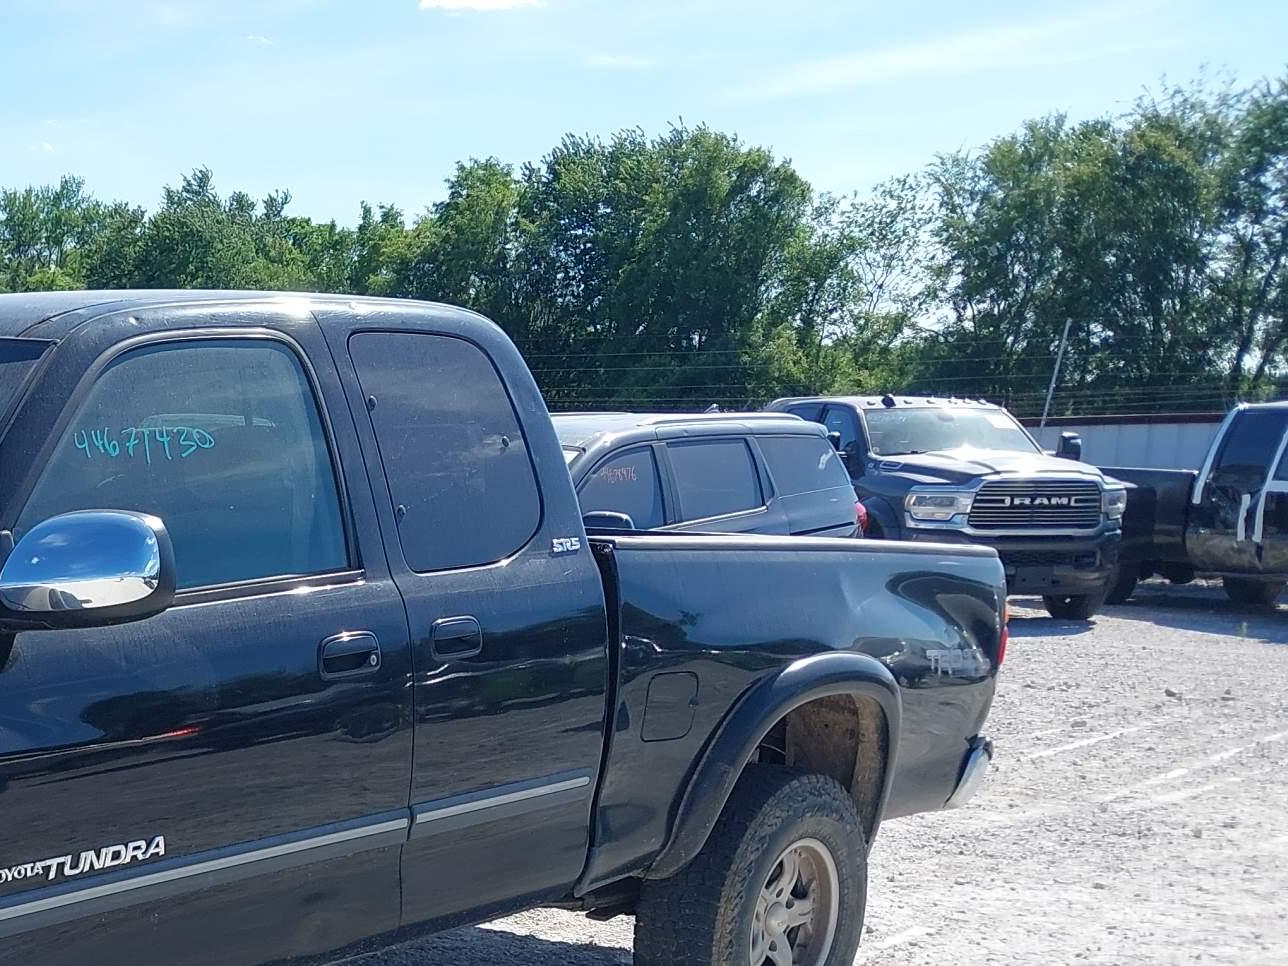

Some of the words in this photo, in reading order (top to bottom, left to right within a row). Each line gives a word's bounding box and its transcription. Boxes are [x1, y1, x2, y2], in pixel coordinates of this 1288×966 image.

[74, 426, 215, 465] 44671430
[1013, 496, 1069, 505] RAM
[42, 835, 165, 880] TUNDRA
